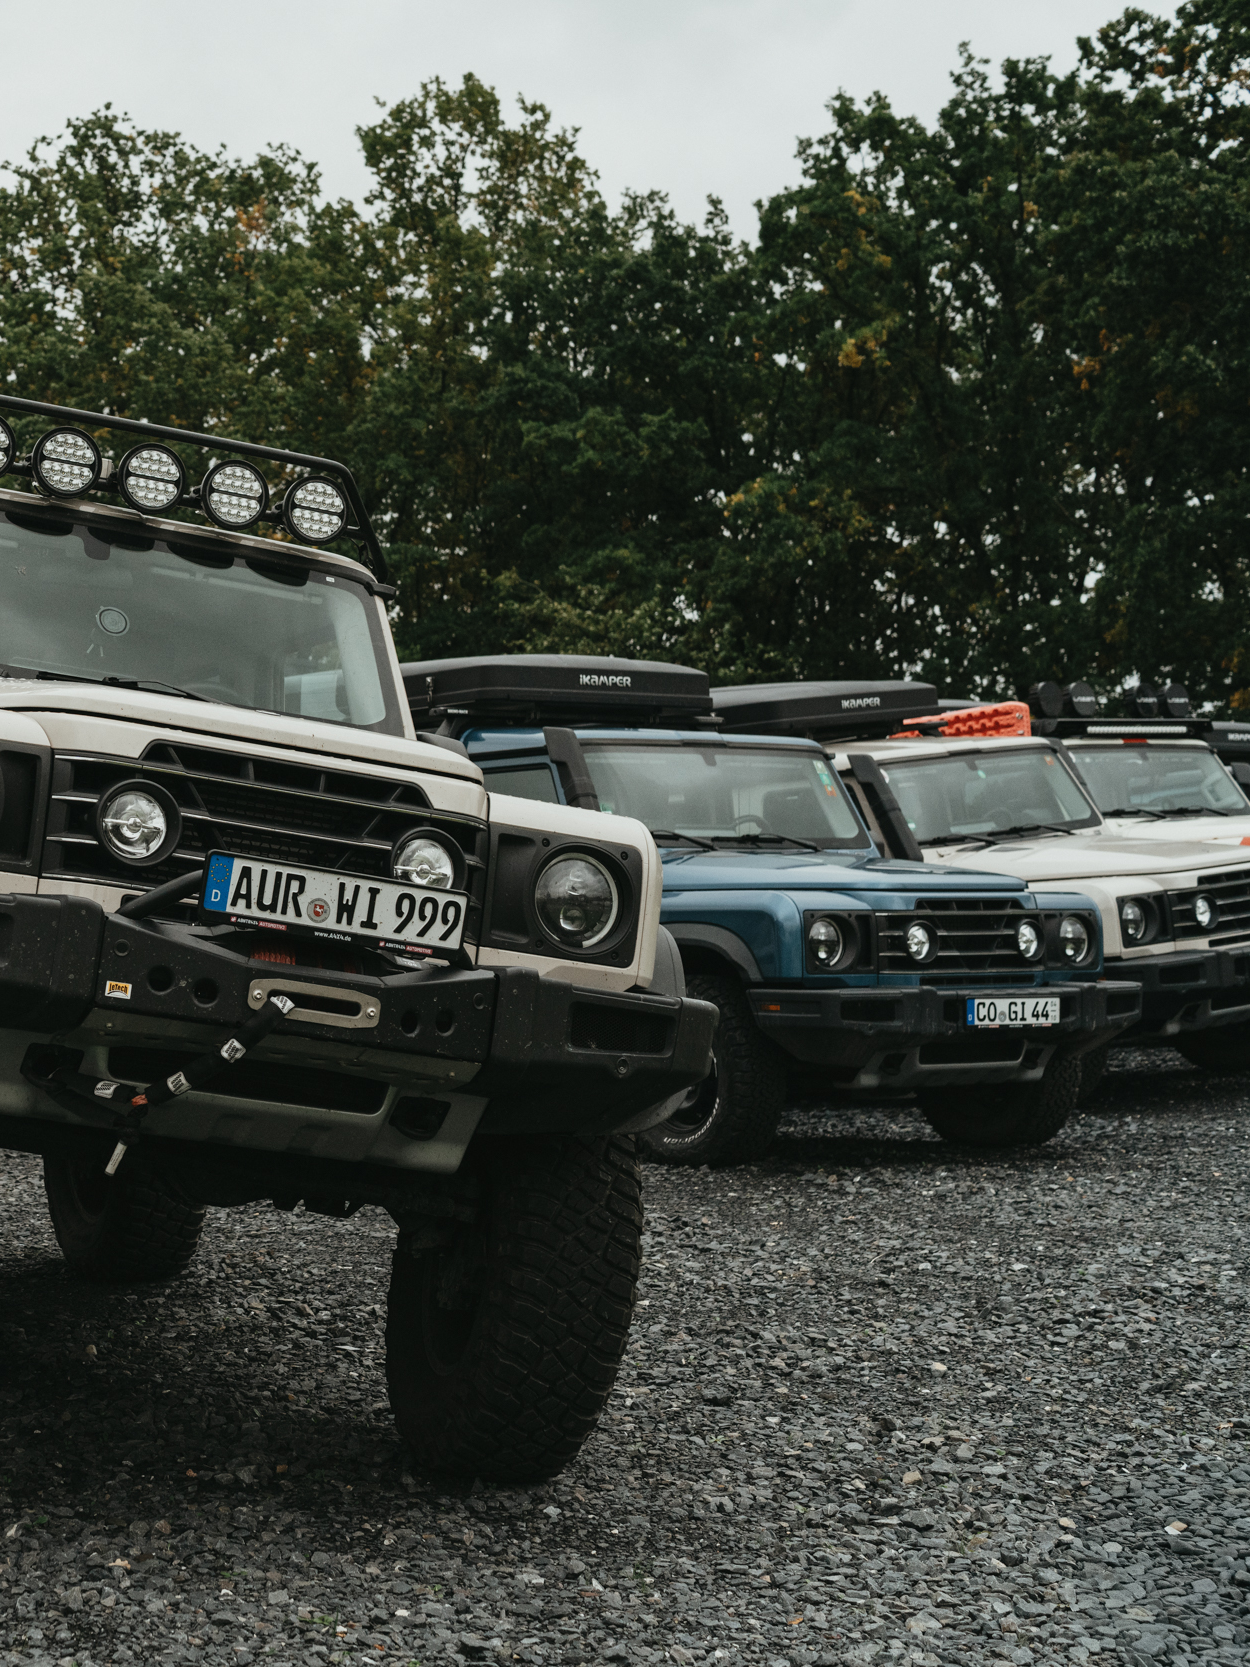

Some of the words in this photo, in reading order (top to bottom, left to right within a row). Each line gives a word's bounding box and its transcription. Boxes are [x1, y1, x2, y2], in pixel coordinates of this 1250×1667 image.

[211, 889, 221, 902] D
[230, 865, 306, 918] AUR
[336, 882, 380, 930] WI
[393, 892, 461, 941] 999
[976, 1001, 997, 1022] CO
[1008, 1001, 1027, 1022] GI
[1031, 1001, 1049, 1021] 44
